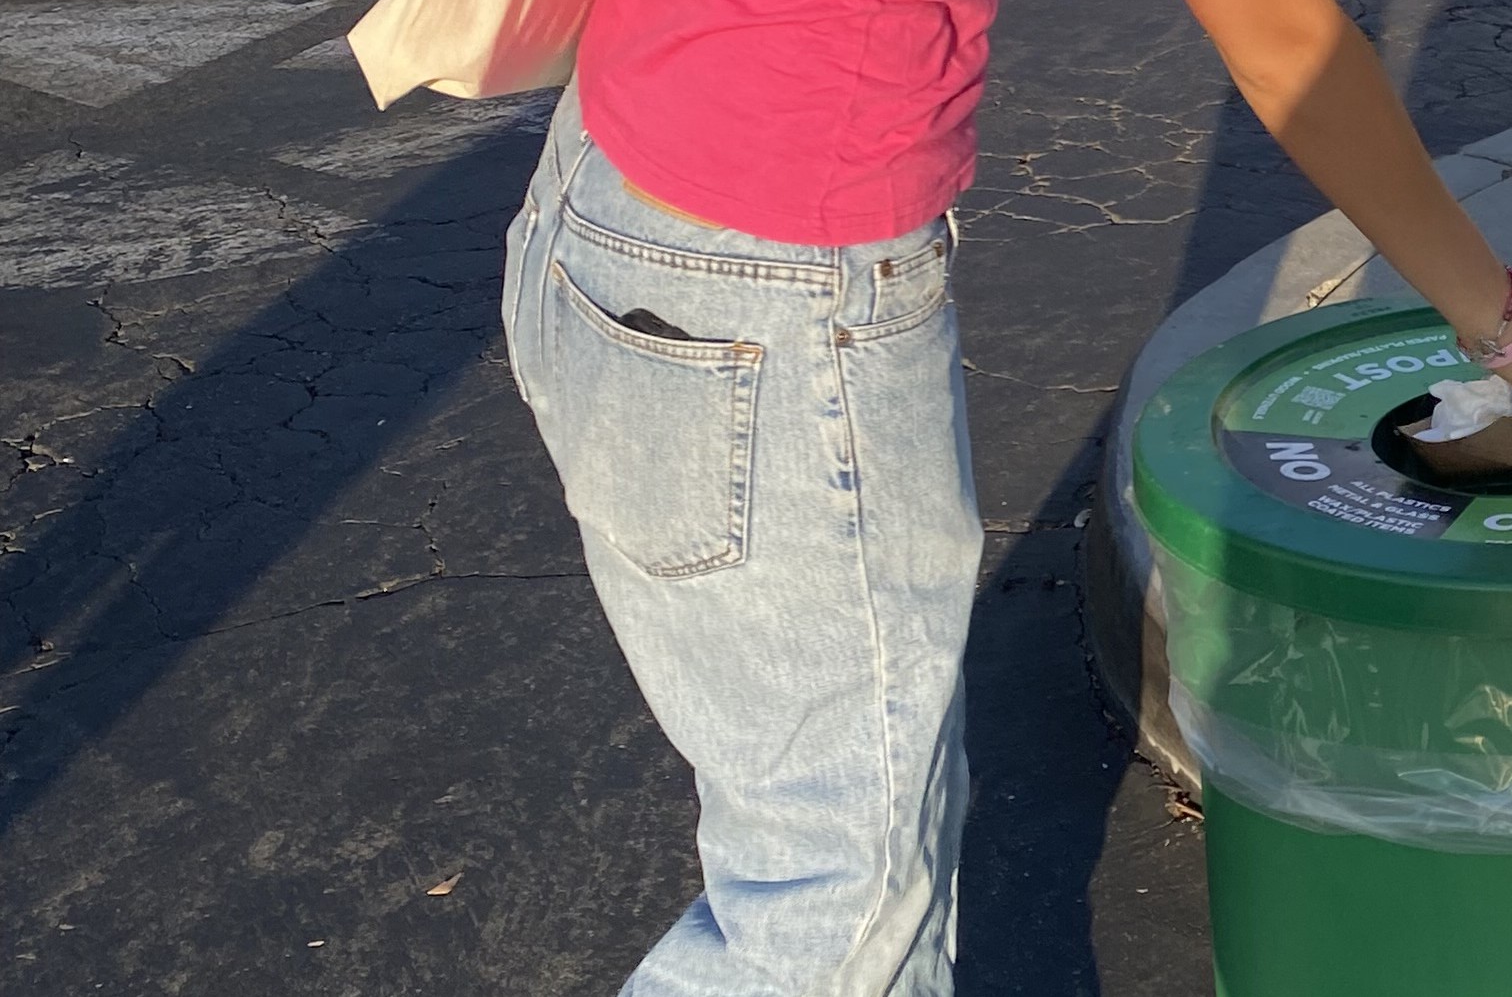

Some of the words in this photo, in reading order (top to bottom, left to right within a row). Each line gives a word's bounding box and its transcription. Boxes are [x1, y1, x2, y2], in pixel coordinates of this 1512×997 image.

[1265, 442, 1331, 481] NO
[1318, 495, 1424, 529] WAX/PLASTIC
[1327, 484, 1369, 504] METAL
[1384, 506, 1440, 521] GLASS
[1350, 481, 1376, 493] ALL
[1376, 491, 1452, 512] PLASTICS
[1307, 500, 1365, 523] COATED
[1365, 520, 1415, 534] ITEMS
